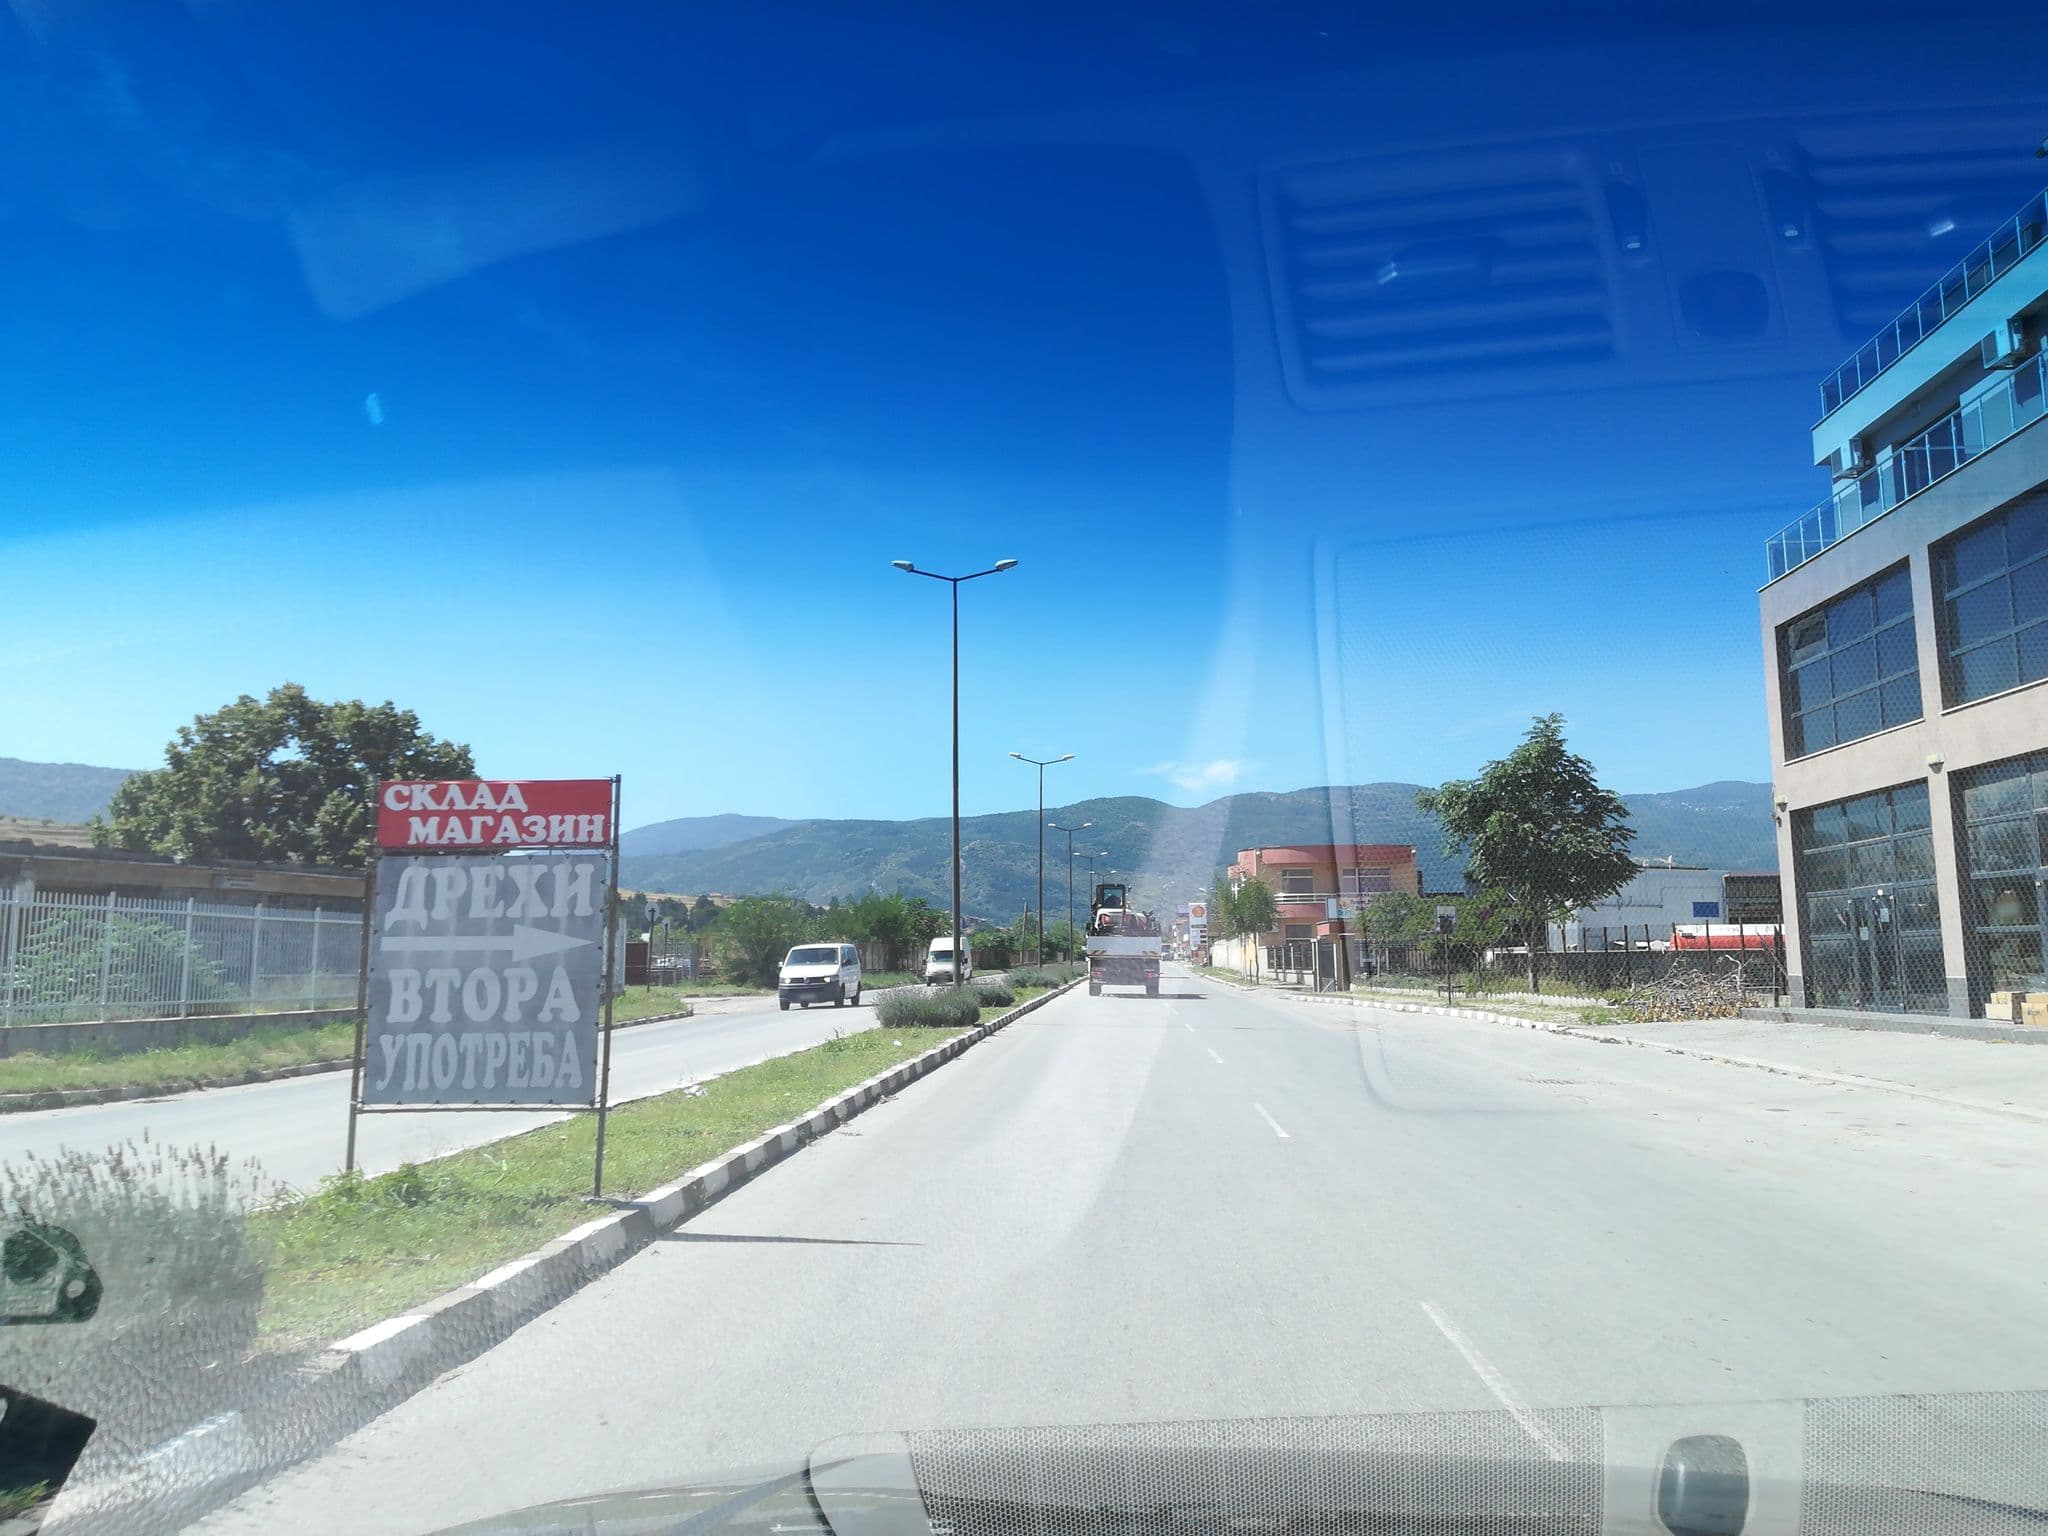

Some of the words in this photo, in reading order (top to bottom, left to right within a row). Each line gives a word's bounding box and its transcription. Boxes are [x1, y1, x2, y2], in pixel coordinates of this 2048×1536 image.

[384, 783, 527, 812] СКЛАД
[408, 814, 605, 844] МАГАЗИН
[385, 863, 594, 930] ДРЕХИ
[386, 967, 580, 1023] ВТОРА
[376, 1030, 583, 1090] УПОТРЕБА
